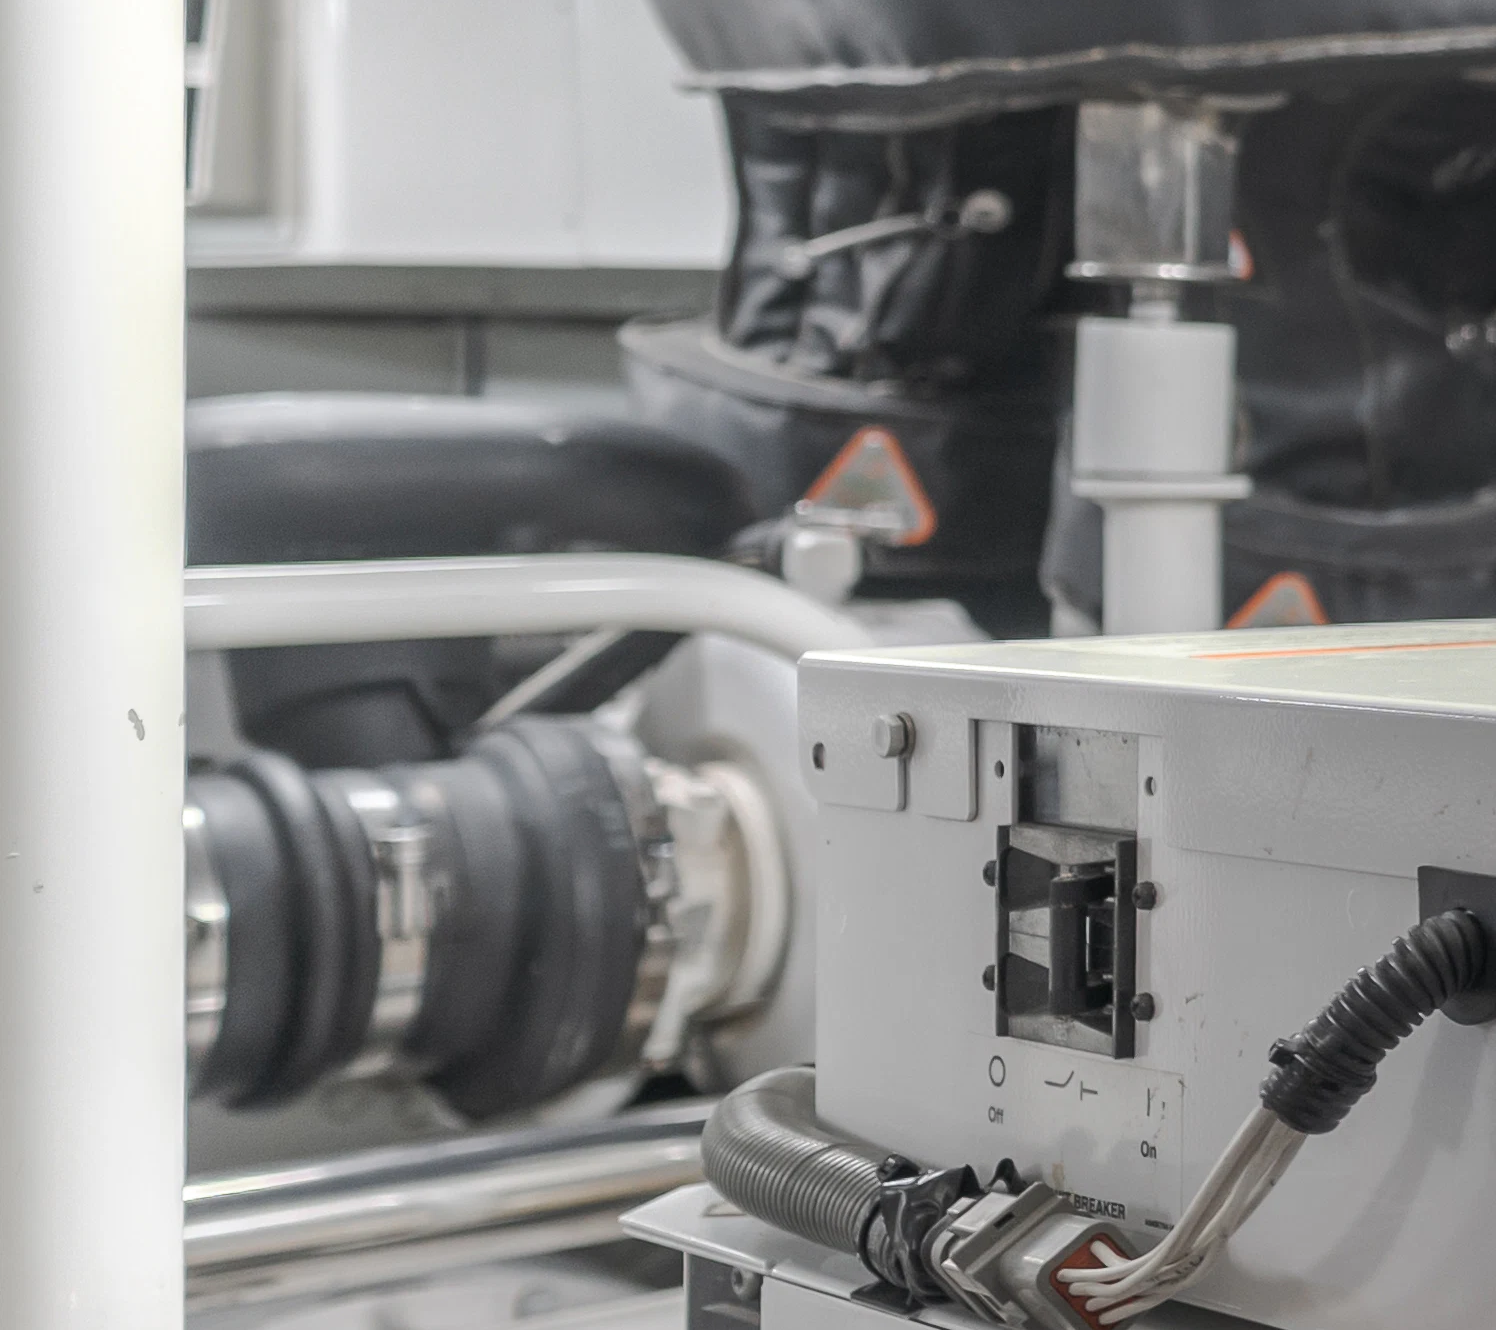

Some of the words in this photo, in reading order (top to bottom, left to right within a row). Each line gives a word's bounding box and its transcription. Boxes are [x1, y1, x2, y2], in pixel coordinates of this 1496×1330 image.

[987, 1105, 1004, 1124] Off
[1140, 1140, 1157, 1159] On
[1073, 1194, 1127, 1221] BREAKER
